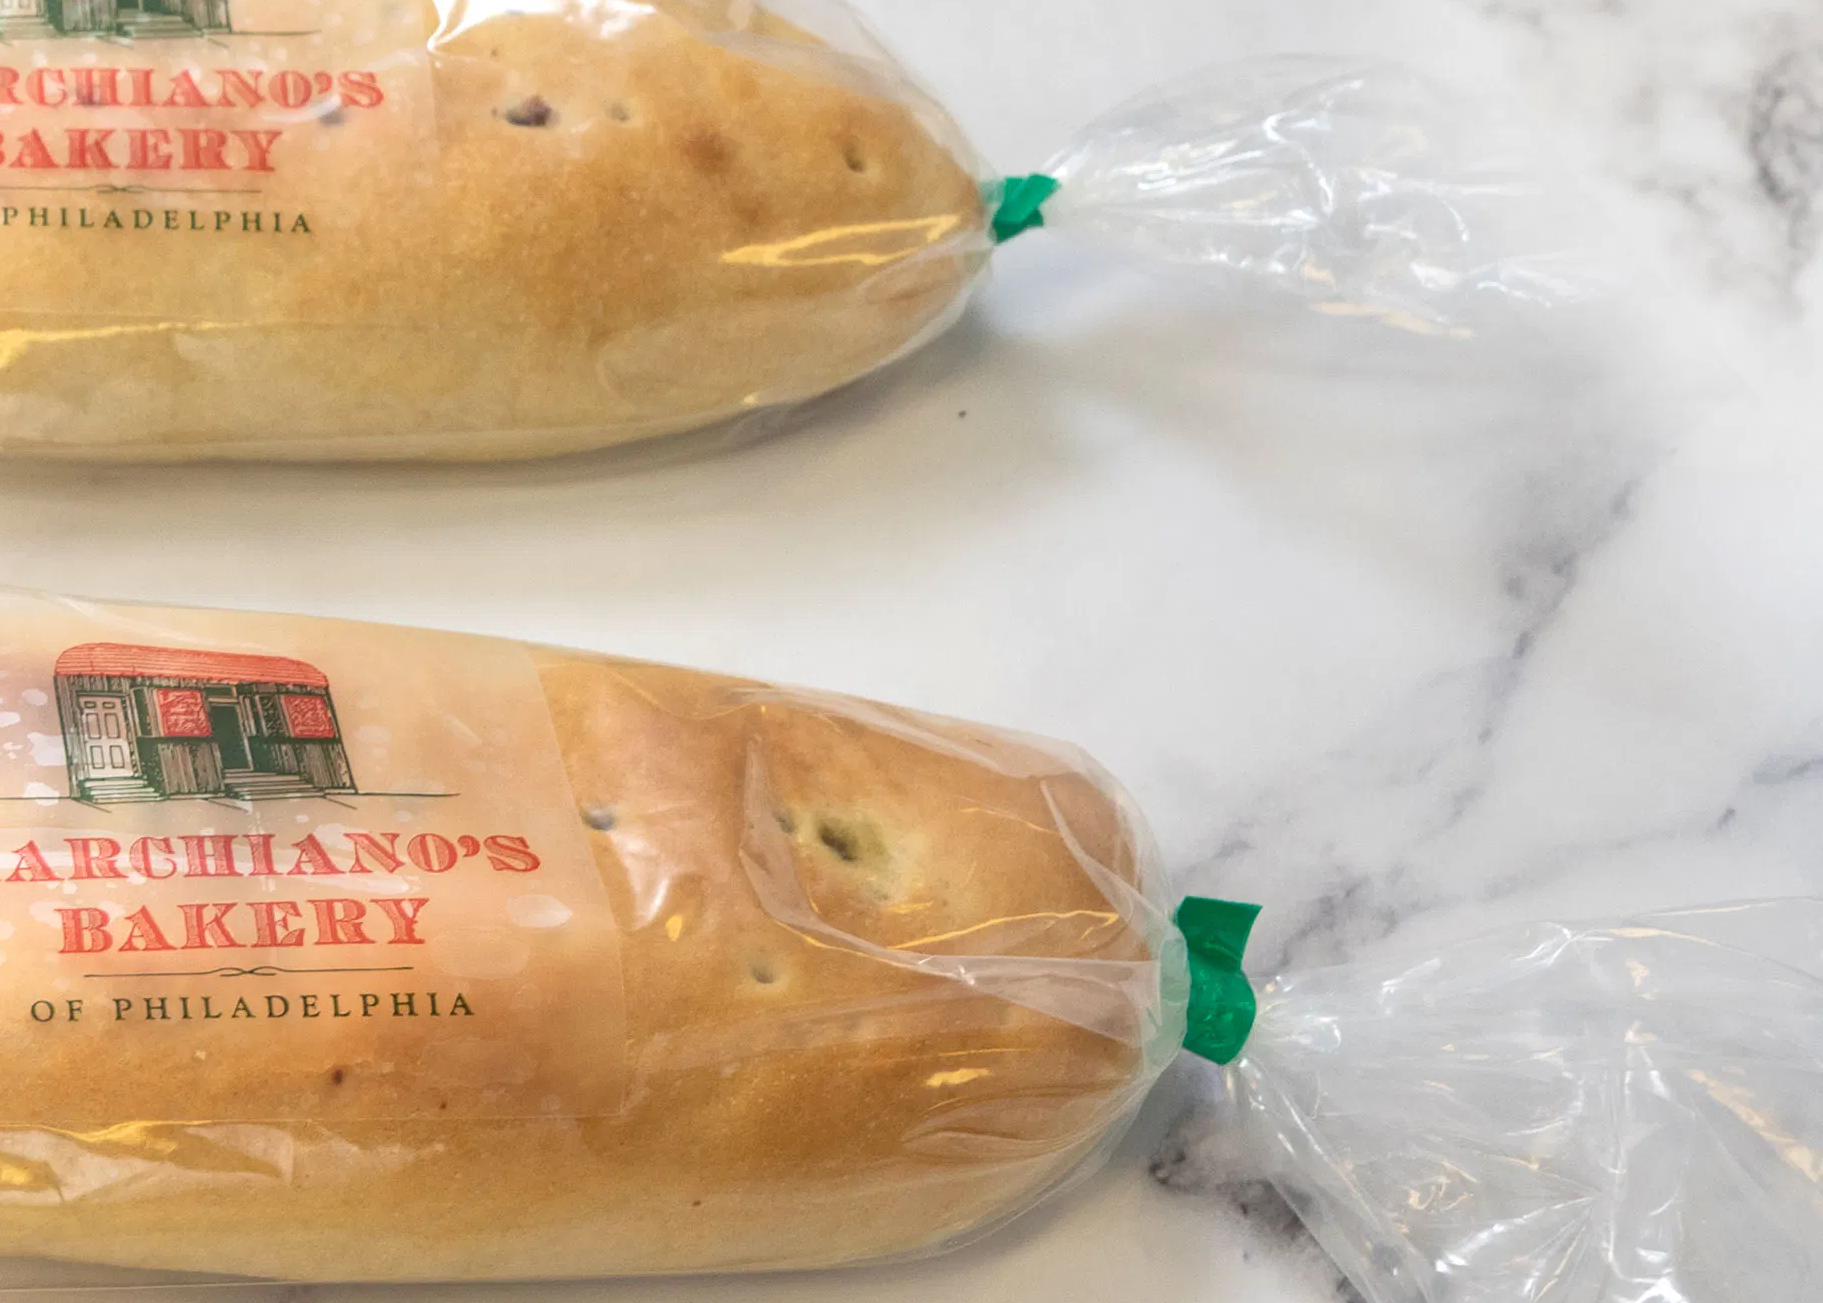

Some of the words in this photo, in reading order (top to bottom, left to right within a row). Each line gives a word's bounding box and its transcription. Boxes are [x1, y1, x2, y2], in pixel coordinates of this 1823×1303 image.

[2, 207, 312, 234] PHILADELPHIA
[55, 898, 430, 954] BAKERY
[30, 999, 84, 1023] OF
[114, 993, 475, 1021] PHILADELPHIA
